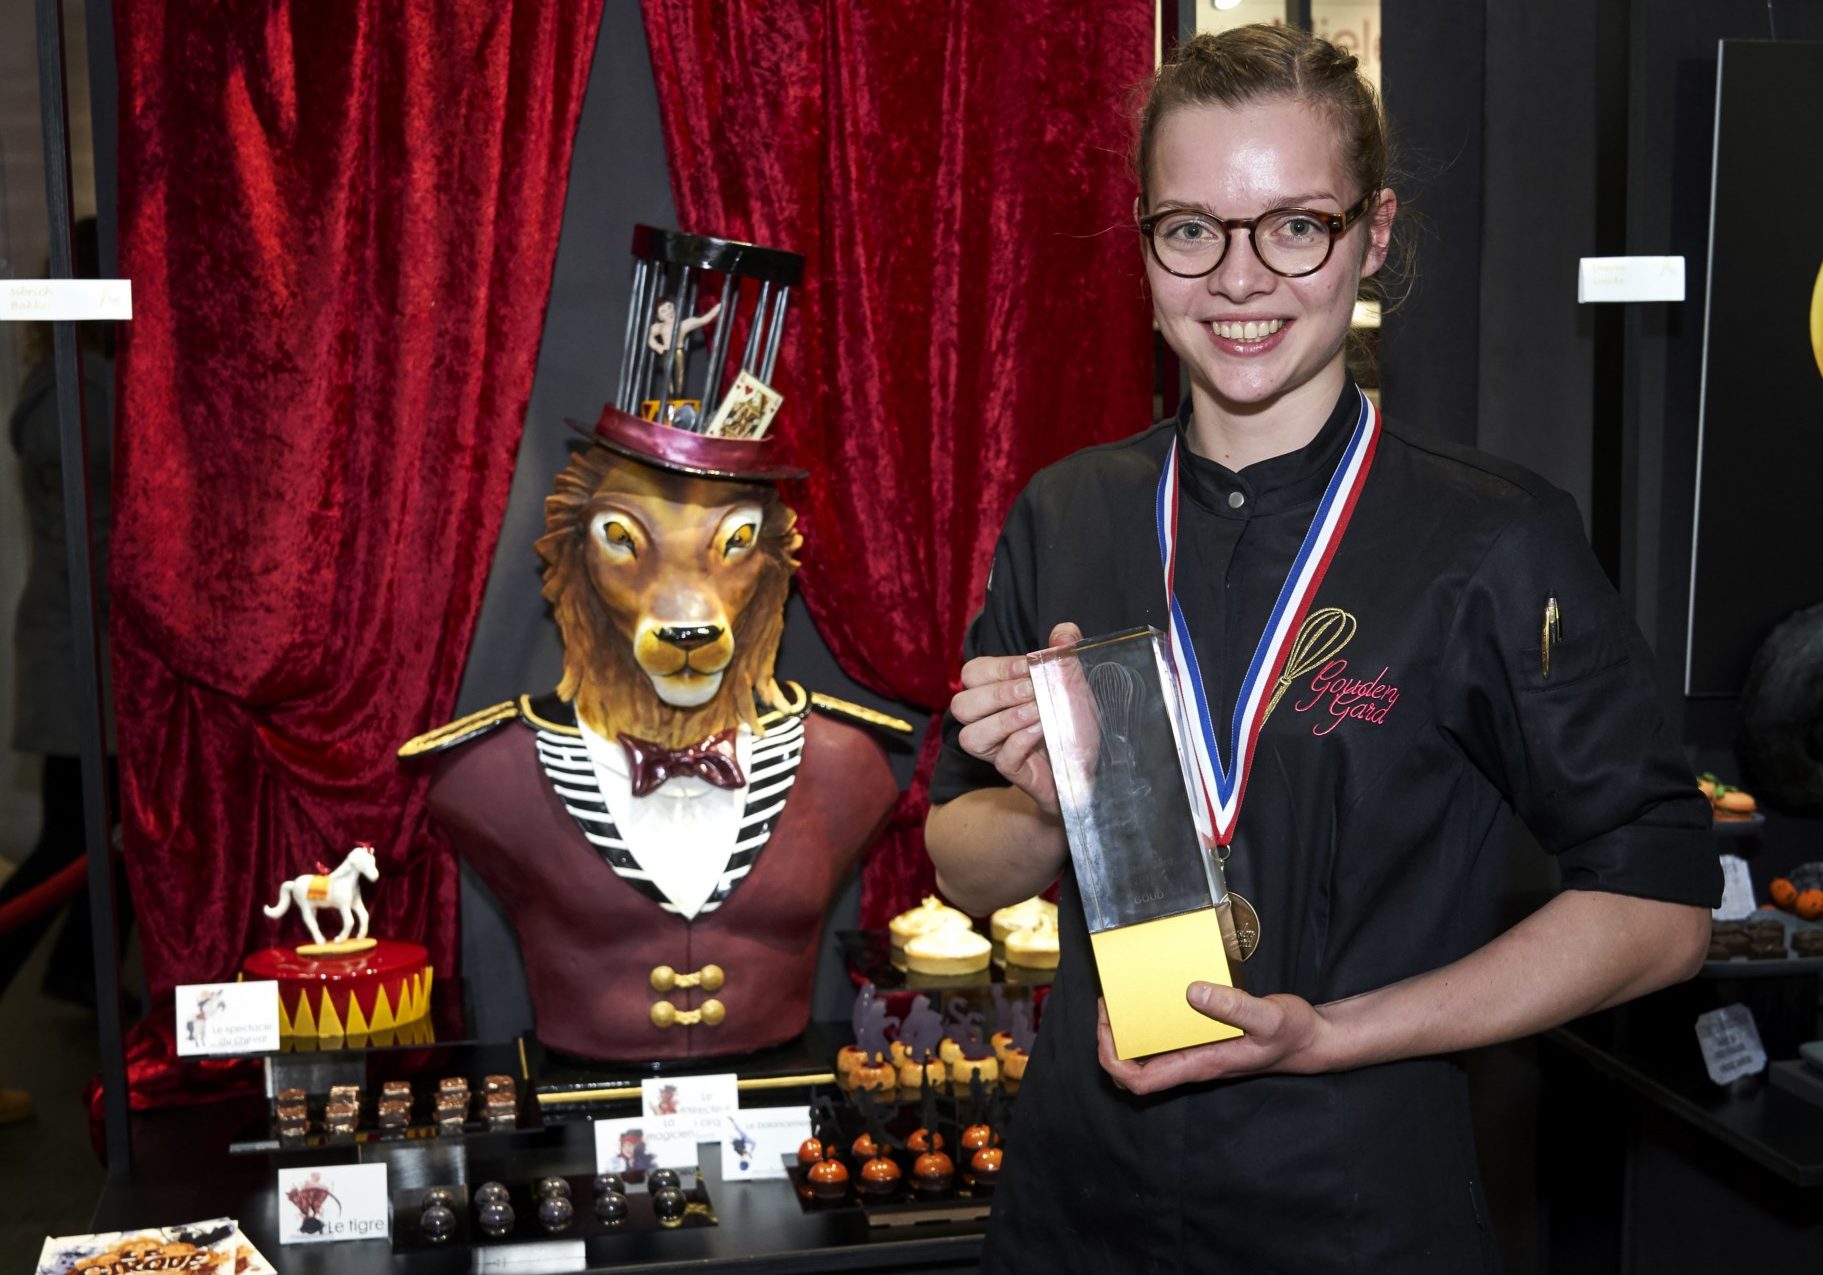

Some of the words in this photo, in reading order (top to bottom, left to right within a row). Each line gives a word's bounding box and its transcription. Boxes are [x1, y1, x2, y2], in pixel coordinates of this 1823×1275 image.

[1295, 659, 1399, 712] Gouden
[1313, 693, 1399, 736] Gard
[327, 1220, 344, 1234] Le
[349, 1218, 385, 1234] tigre
